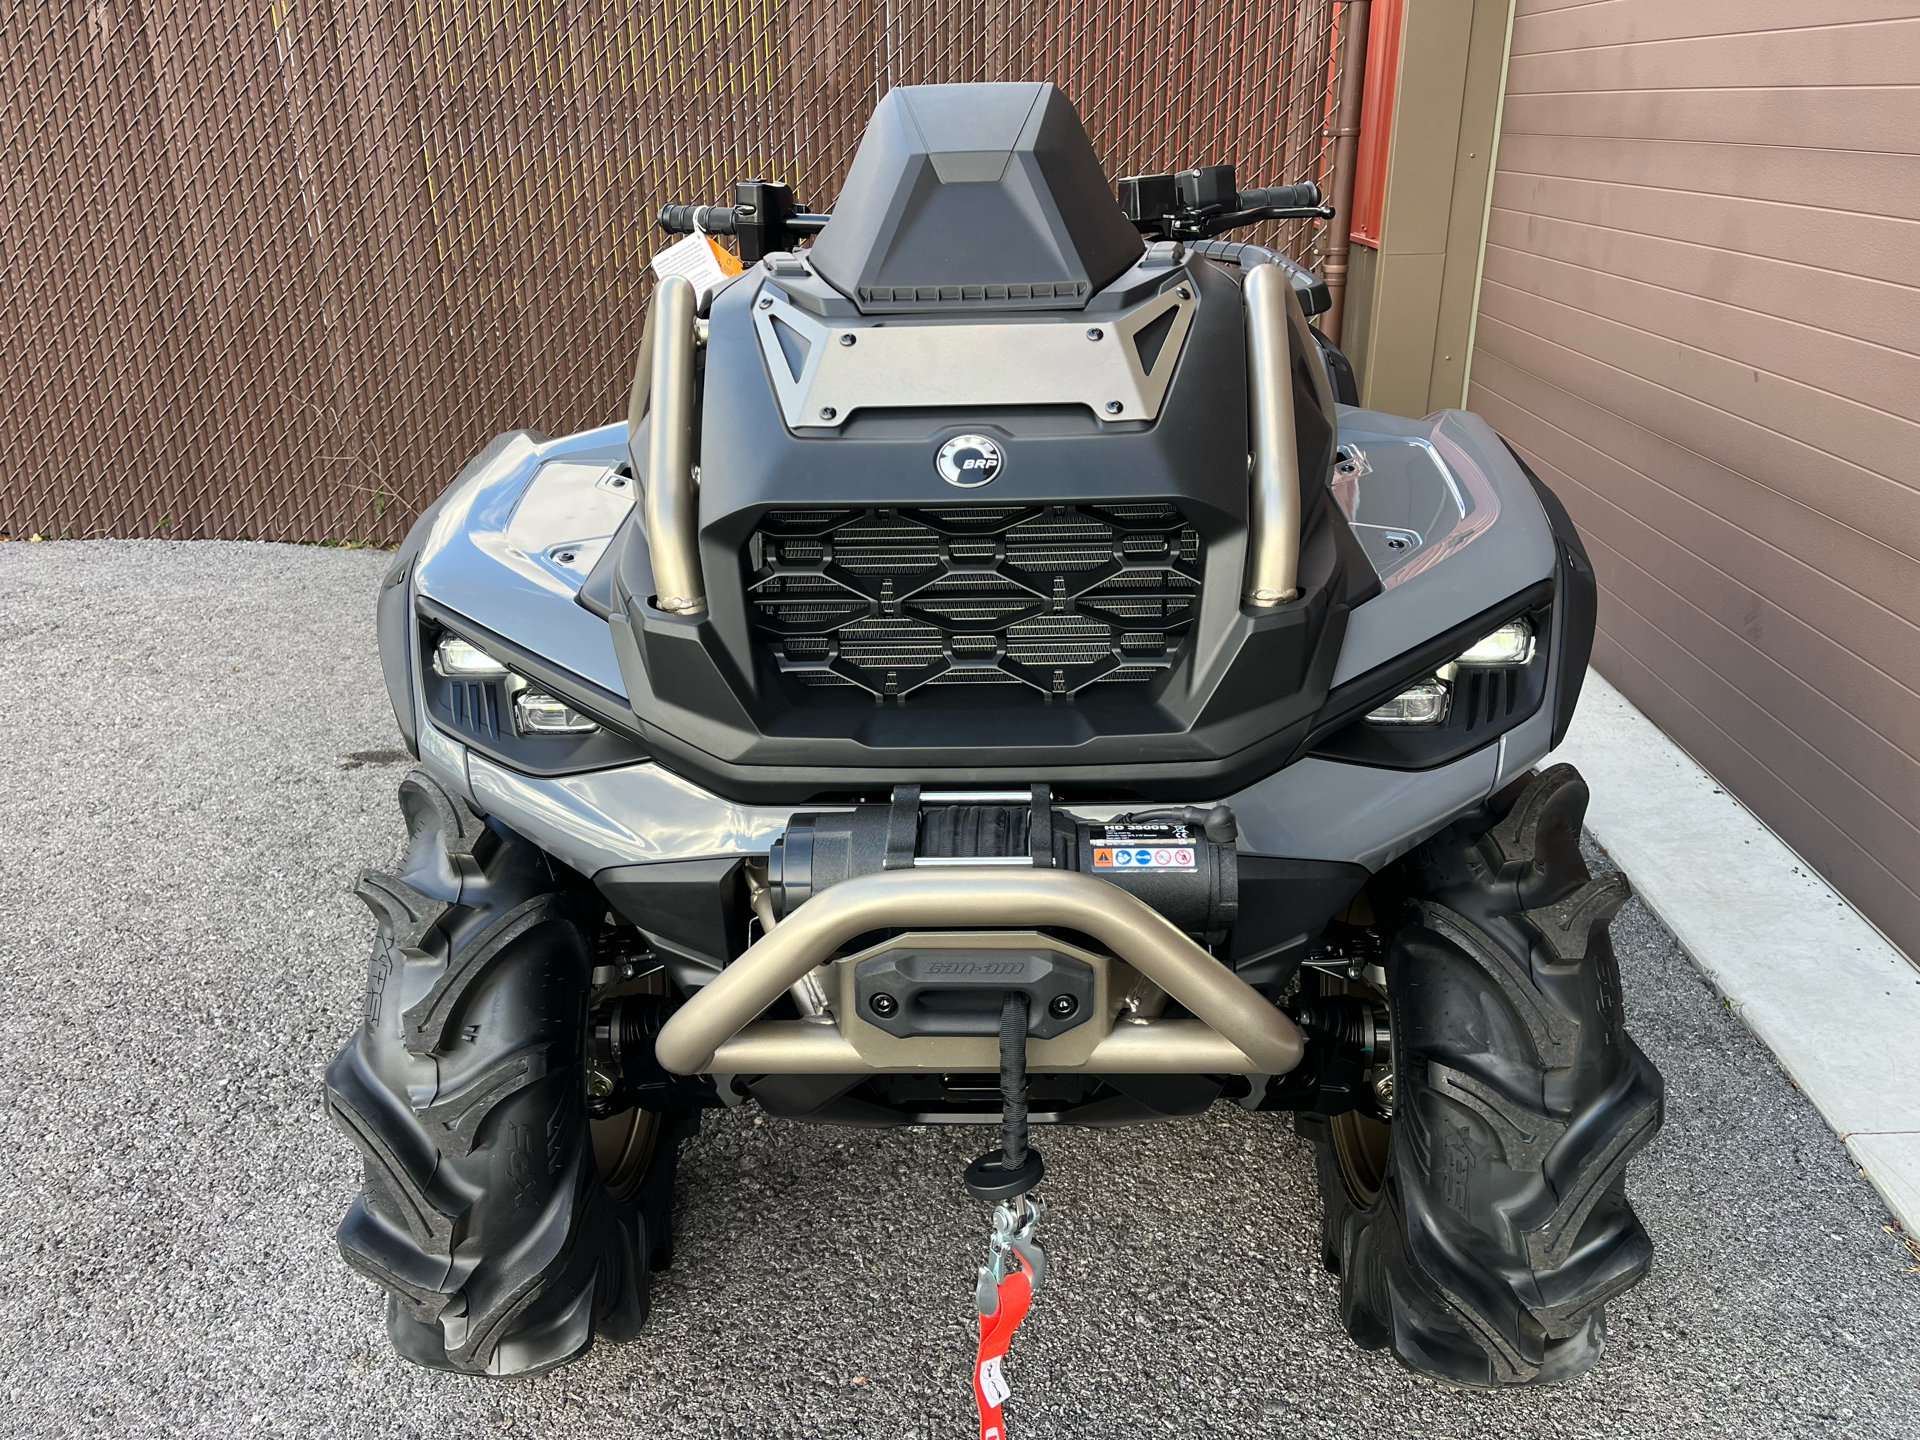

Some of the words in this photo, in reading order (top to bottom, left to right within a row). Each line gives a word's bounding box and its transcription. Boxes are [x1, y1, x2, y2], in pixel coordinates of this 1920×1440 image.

[962, 459, 998, 470] BRP
[367, 931, 395, 1027] XPS
[924, 962, 1024, 975] can-am
[505, 1120, 540, 1212] XPS
[1444, 1113, 1475, 1217] XPS
